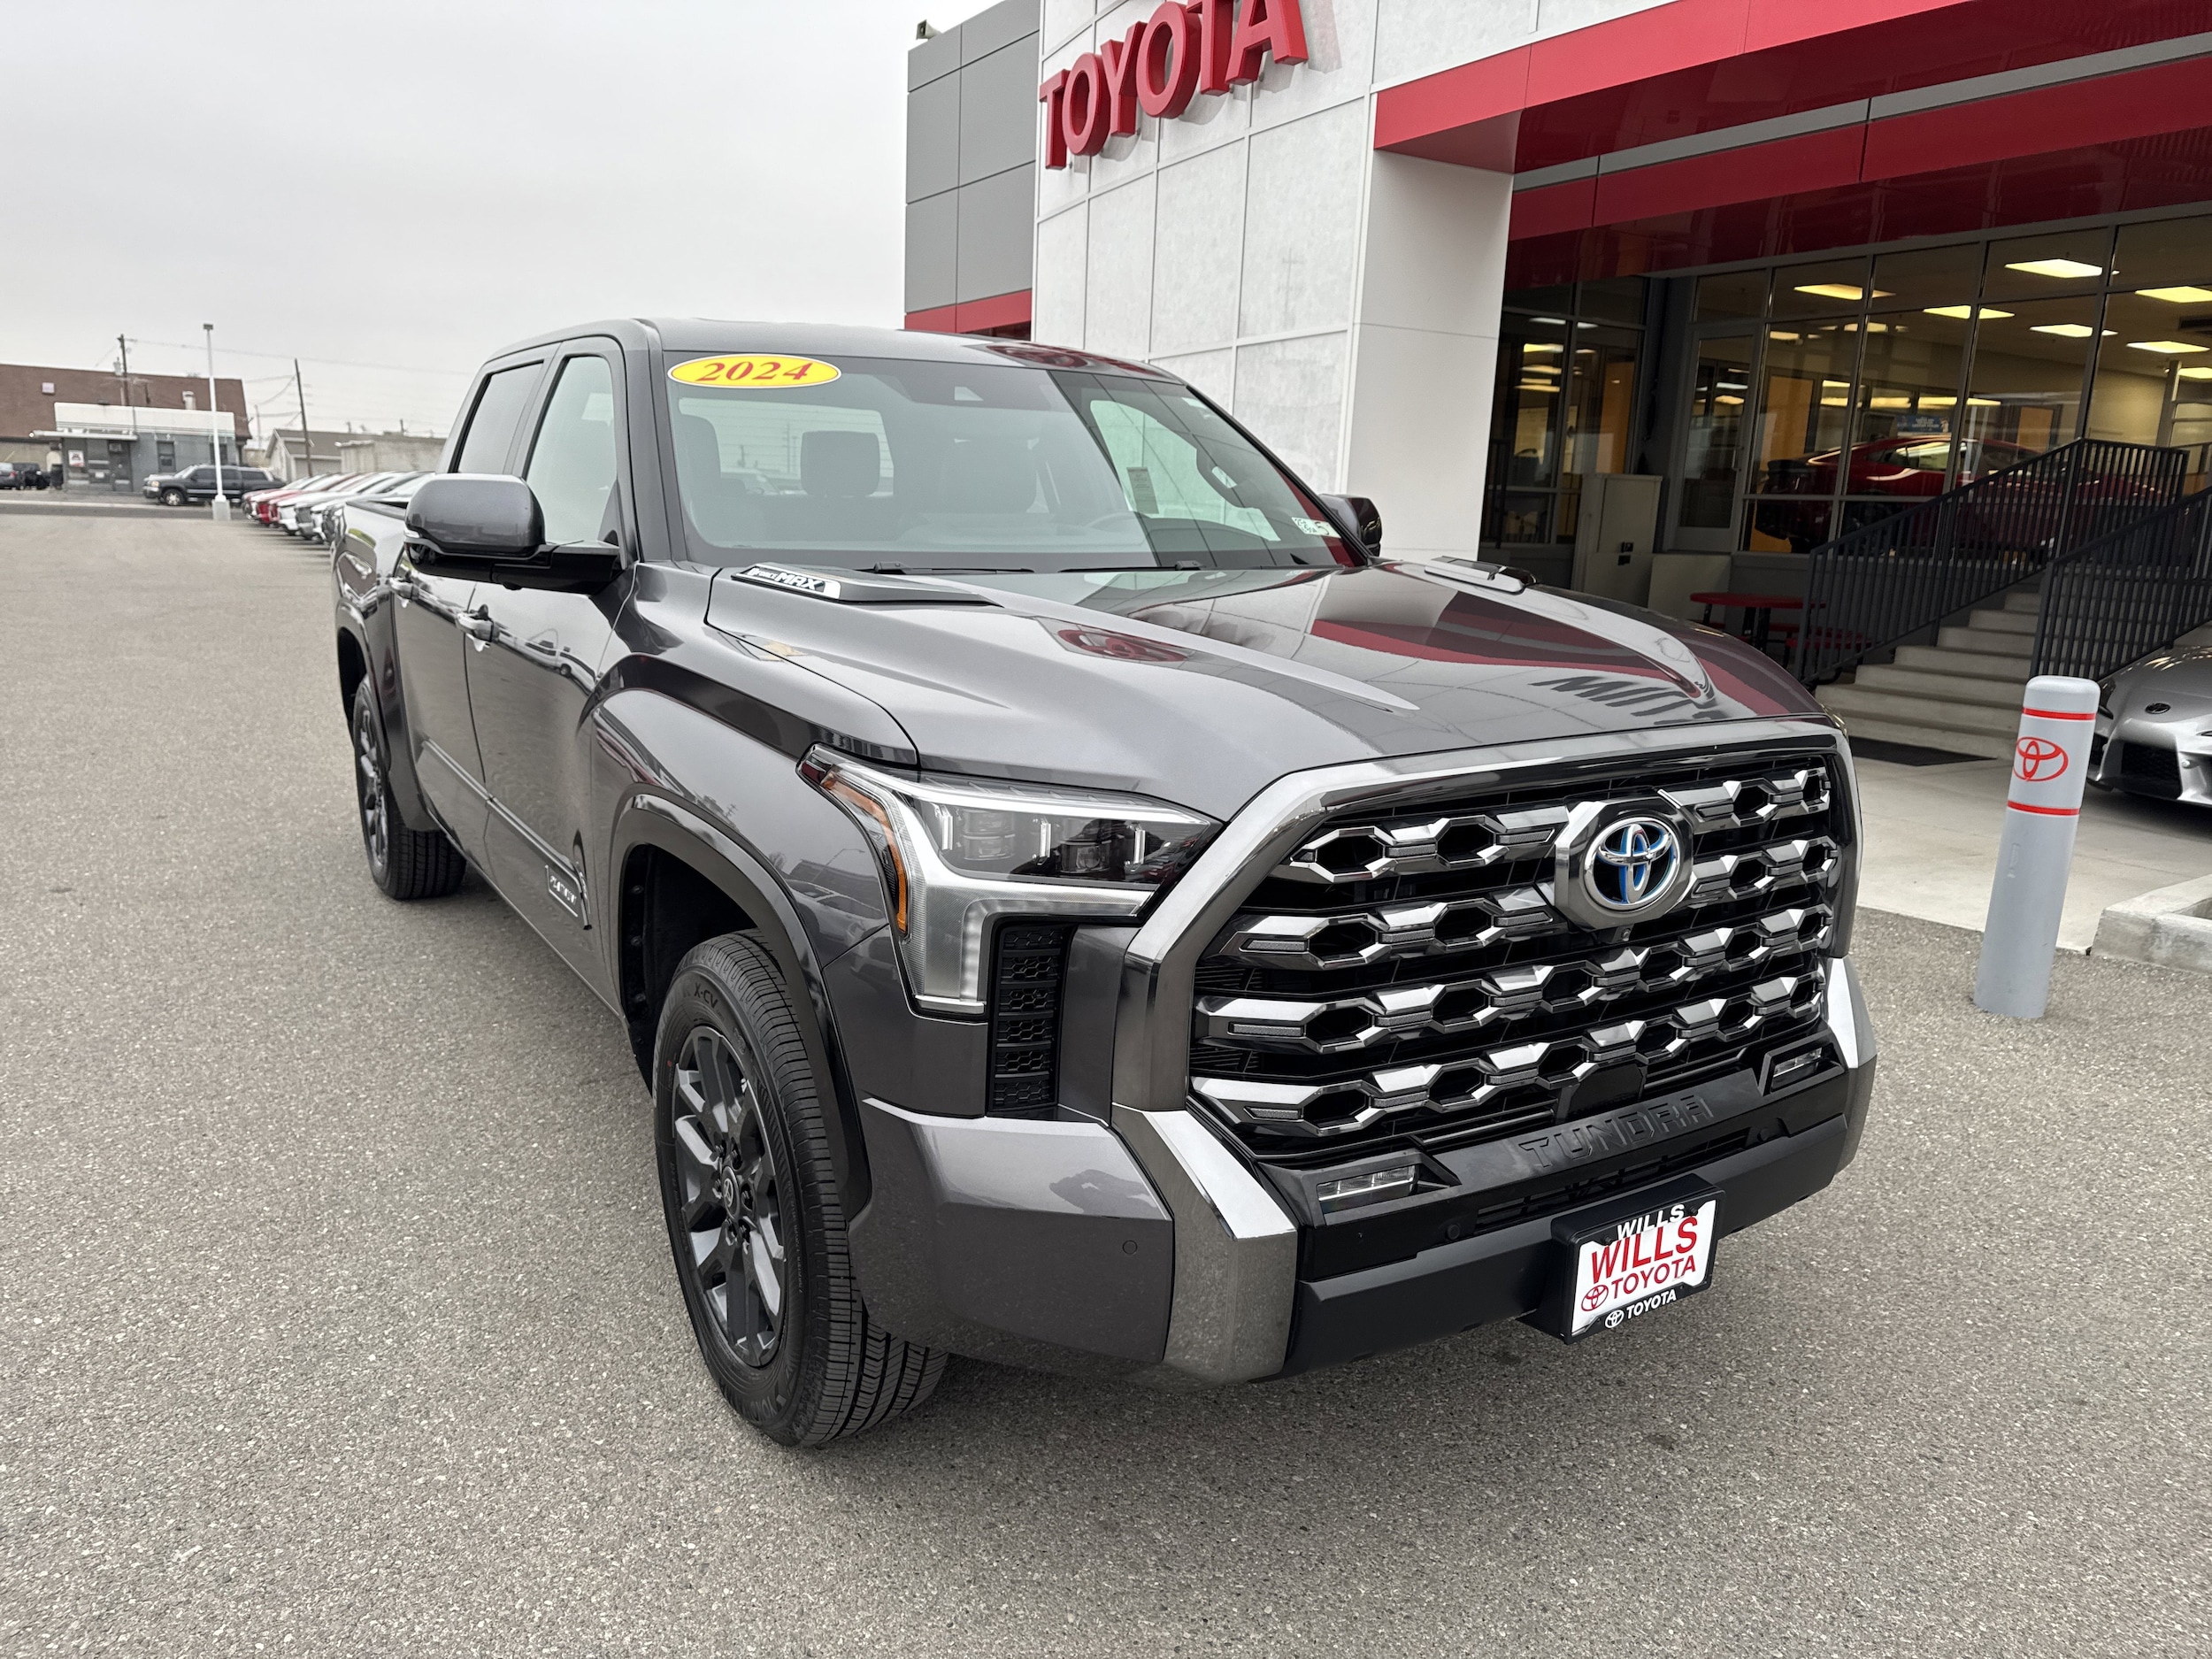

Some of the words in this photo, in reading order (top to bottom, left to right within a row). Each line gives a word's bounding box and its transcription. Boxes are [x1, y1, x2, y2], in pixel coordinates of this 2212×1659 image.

[1040, 0, 1309, 170] TOYOTA
[695, 362, 813, 381] 2024
[774, 572, 825, 590] MAX
[1518, 1094, 1714, 1168] TUNDRA
[1617, 1204, 1685, 1240] WILLS
[1592, 1215, 1698, 1284] WILLS
[1611, 1255, 1696, 1299] TOYOTA
[1626, 1289, 1677, 1319] TOYOTA
